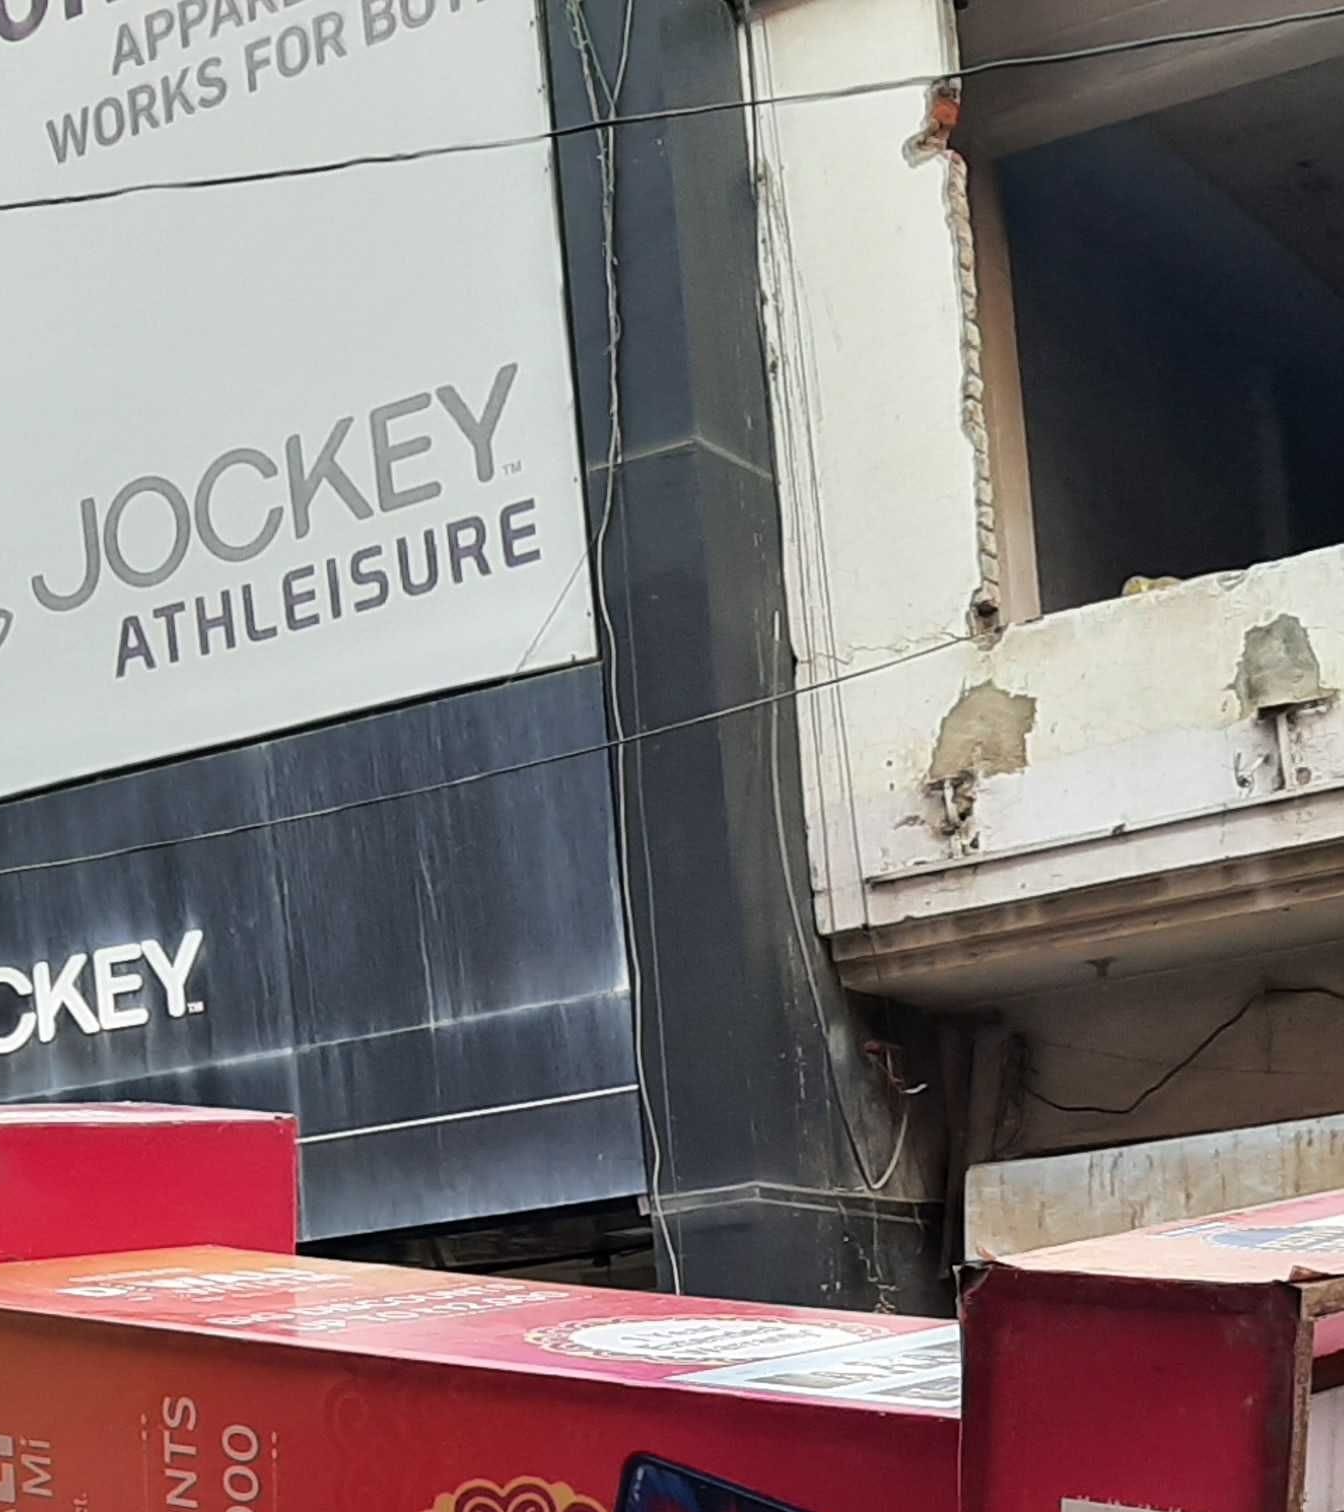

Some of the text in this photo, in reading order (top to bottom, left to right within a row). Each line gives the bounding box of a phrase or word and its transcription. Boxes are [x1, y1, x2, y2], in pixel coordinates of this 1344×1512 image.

[45, 56, 229, 163] WORKS
[243, 10, 348, 93] FOR
[31, 362, 518, 612] JOCKEY
[115, 498, 542, 678] ATHLEISURE
[20, 1437, 52, 1498] Mi
